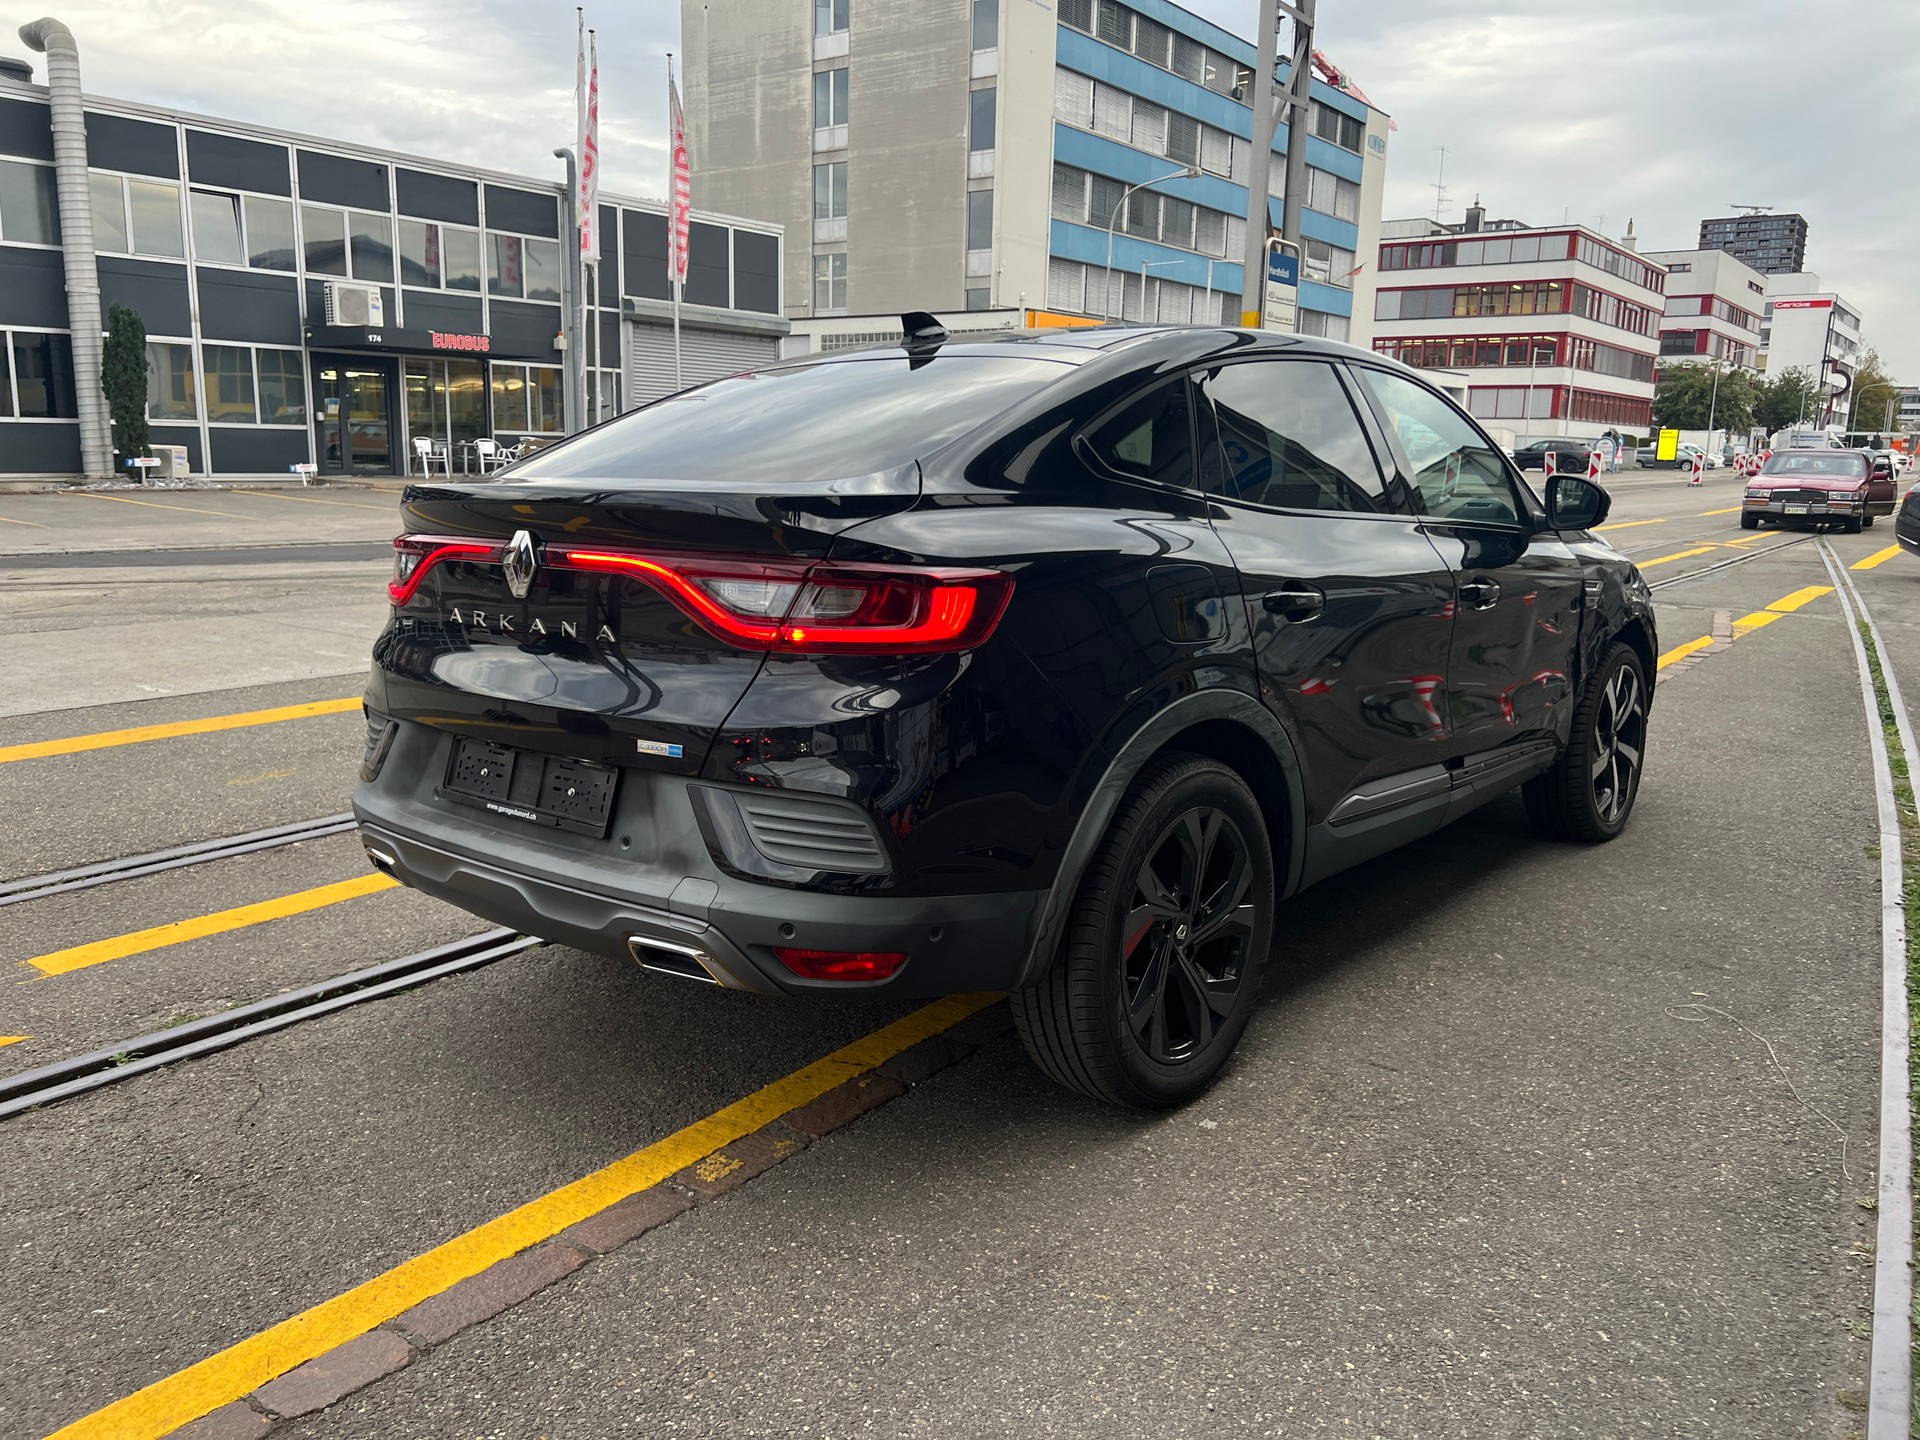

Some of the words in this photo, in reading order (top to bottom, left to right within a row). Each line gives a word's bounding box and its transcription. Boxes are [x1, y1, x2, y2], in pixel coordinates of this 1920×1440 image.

[368, 334, 382, 343] 174
[432, 332, 490, 351] EUROBUS
[449, 607, 617, 643] ARKANA
[486, 803, 537, 820] www.garagedunord.ch
